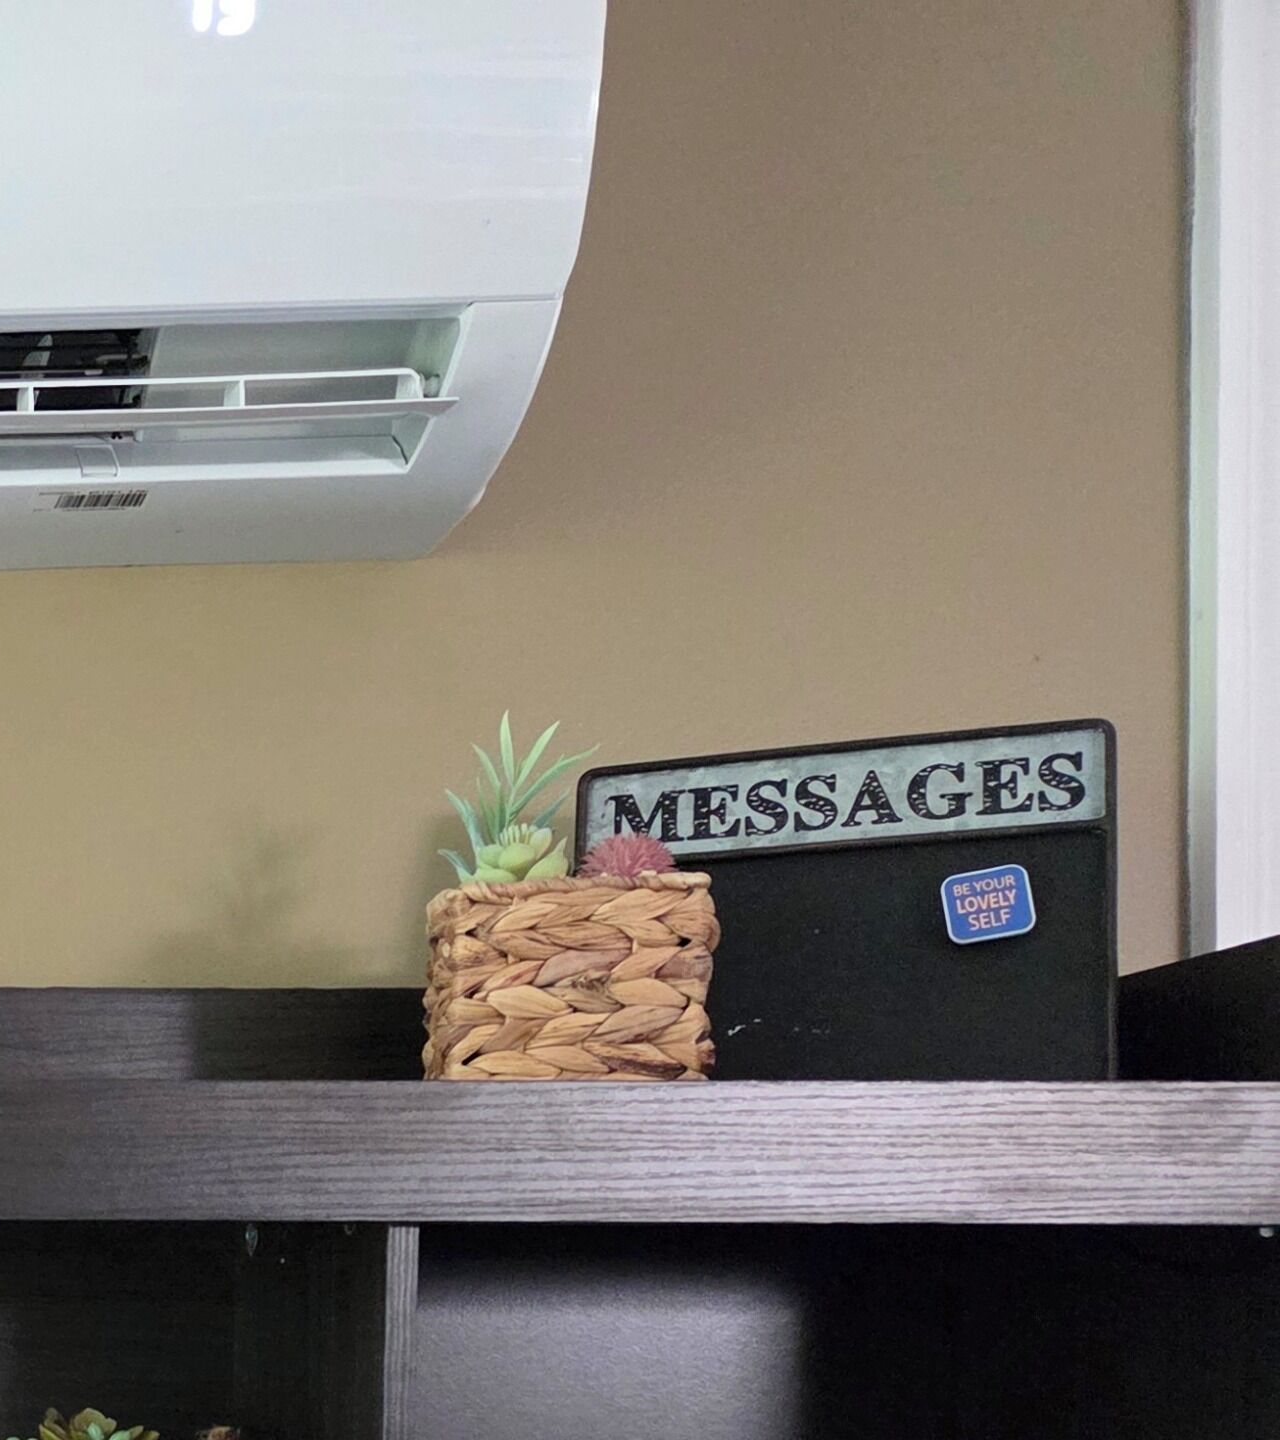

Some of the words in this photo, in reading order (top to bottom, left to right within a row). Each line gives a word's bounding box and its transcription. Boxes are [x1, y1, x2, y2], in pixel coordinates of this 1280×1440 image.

[605, 751, 1087, 842] MESSAGES
[952, 883, 970, 897] BE
[973, 874, 1017, 892] YOUR
[956, 889, 1017, 914] LOVELY
[968, 909, 1011, 931] SELF
